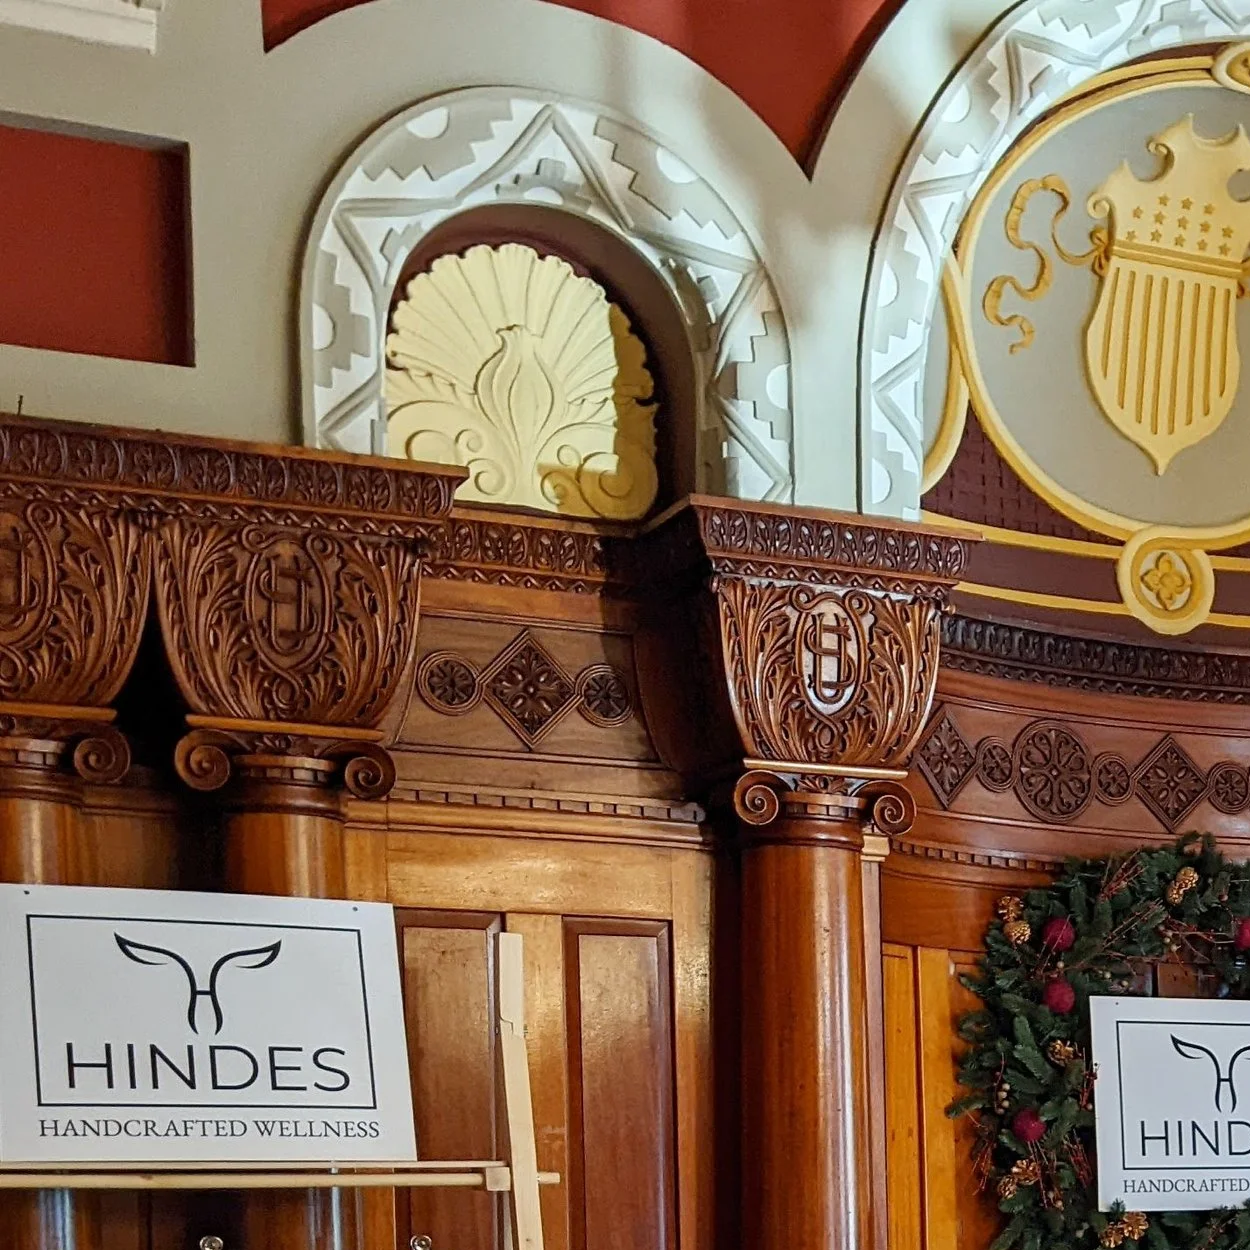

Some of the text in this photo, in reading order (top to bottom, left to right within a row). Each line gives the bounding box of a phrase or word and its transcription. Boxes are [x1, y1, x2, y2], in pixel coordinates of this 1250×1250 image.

[65, 1042, 352, 1092] HINDES
[39, 1118, 381, 1139] HANDCRAFTED WELLNESS
[1123, 1178, 1250, 1194] HANDCRAFTED
